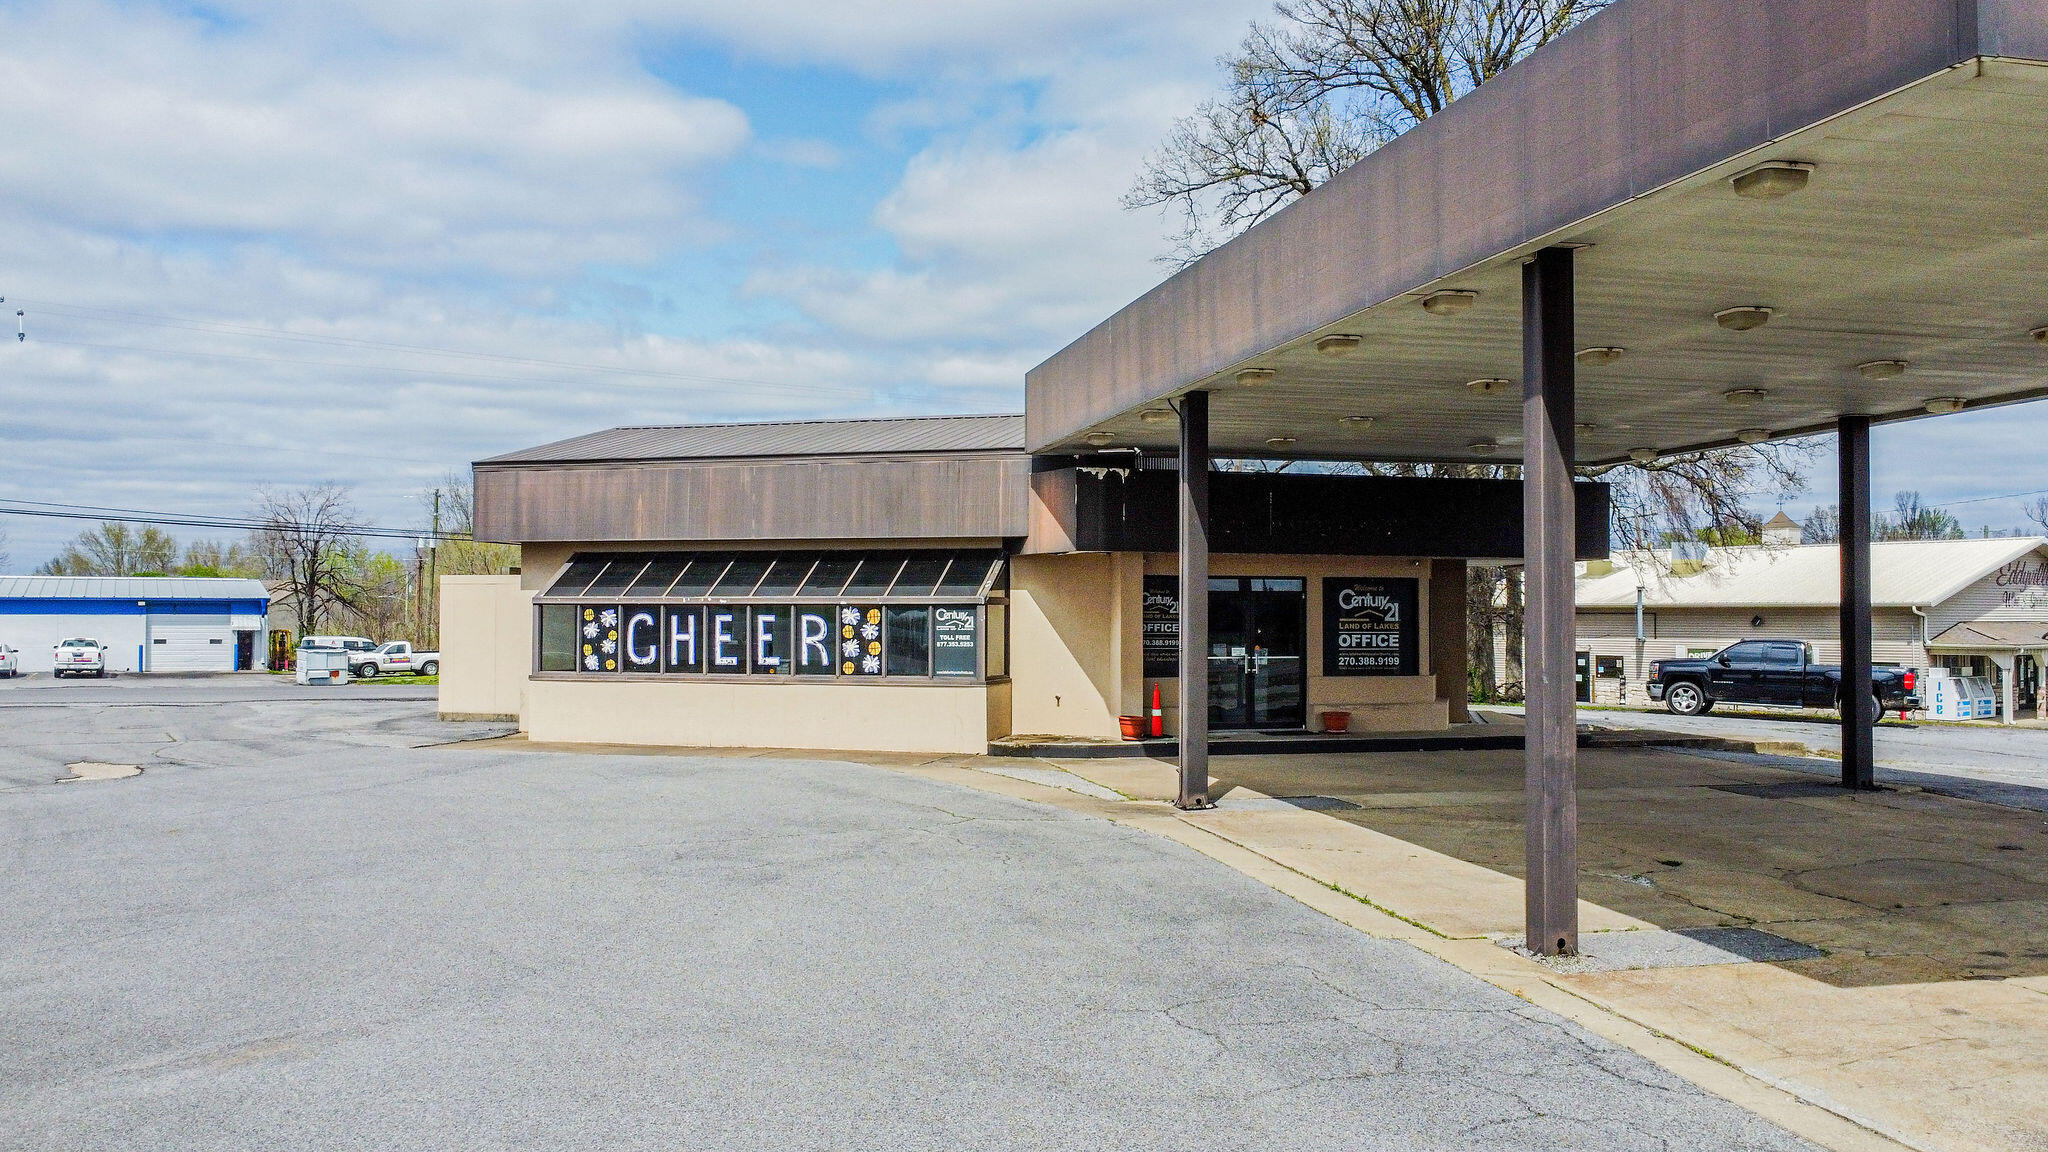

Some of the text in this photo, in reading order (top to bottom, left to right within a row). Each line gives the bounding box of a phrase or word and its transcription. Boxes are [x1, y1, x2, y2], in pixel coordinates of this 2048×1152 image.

[1996, 561, 2048, 592] Eddyvill
[1339, 589, 1399, 621] Century 21
[936, 608, 968, 621] Century
[964, 615, 974, 628] 21
[1339, 622, 1360, 630] LAND
[1373, 622, 1400, 630] LAKES
[627, 612, 829, 666] CHEER
[1338, 634, 1400, 647] OFFICE
[1338, 656, 1400, 666] 270.388.9199
